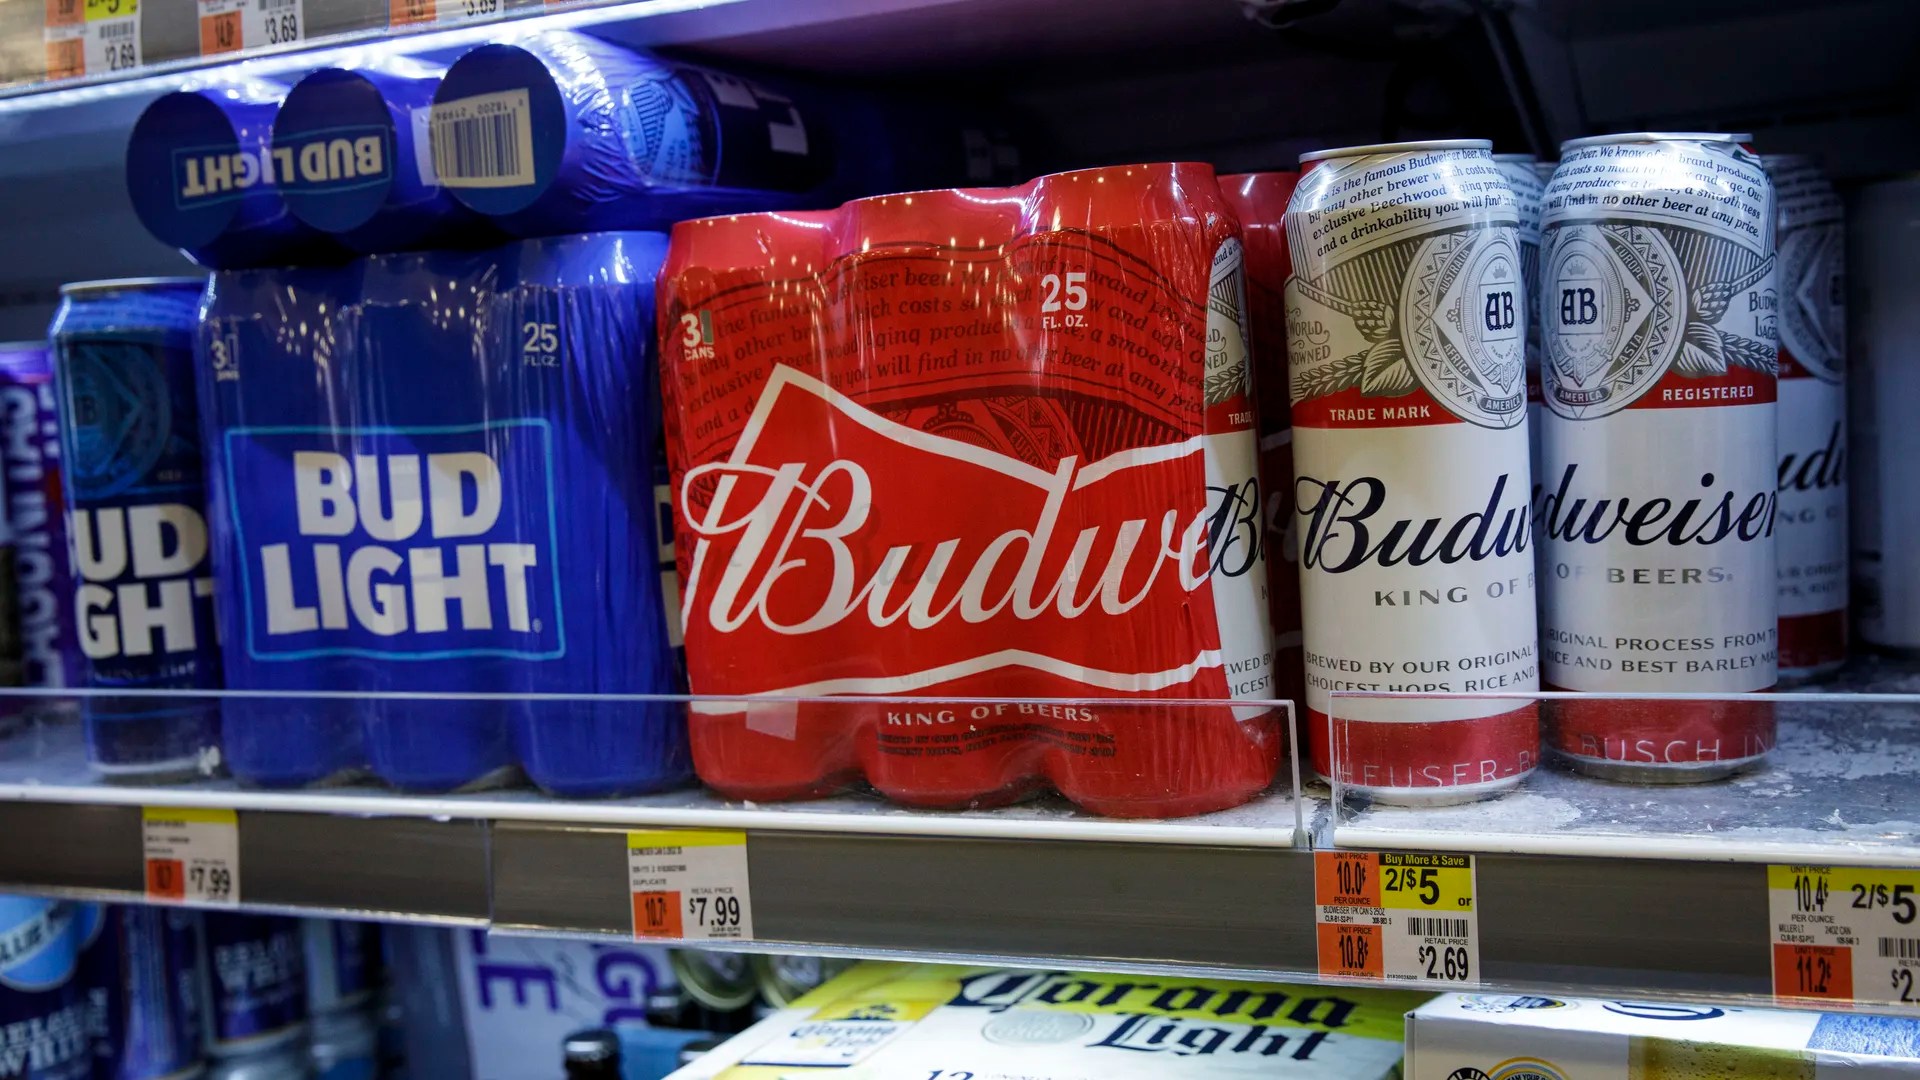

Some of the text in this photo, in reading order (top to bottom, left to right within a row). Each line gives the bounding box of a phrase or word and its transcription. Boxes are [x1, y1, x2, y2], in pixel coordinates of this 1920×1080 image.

[265, 15, 298, 44] $3.69
[182, 136, 383, 198] BUD LIGHT
[1332, 148, 1479, 196] is the famous Budweiser beer.
[1570, 164, 1592, 176] costs
[1593, 164, 1605, 173] so
[1695, 171, 1718, 185] and
[1722, 180, 1745, 193] ge.
[1580, 145, 1762, 187] beer. We know brand produced
[1308, 212, 1321, 224] by
[1324, 199, 1345, 215] any
[1350, 185, 1383, 204] other
[1387, 173, 1429, 192] brewer
[1465, 165, 1486, 176] costs
[1684, 187, 1693, 195] a
[1696, 189, 1761, 219] smoothness
[1313, 181, 1481, 240] exclusive Beechwood ging
[1317, 194, 1501, 257] and a drinkability you will find
[1563, 193, 1585, 209] find
[1588, 193, 1598, 204] in
[1602, 195, 1619, 205] no
[1622, 192, 1659, 207] other
[1662, 196, 1693, 212] beer
[1695, 205, 1709, 217] at
[1711, 210, 1734, 226] any
[1734, 218, 1760, 238] price.
[1439, 249, 1470, 294] AUSTRALIA
[1614, 245, 1644, 281] EUROPE
[1041, 272, 1088, 313] 25
[1089, 268, 1148, 304] brand
[1042, 315, 1088, 329] FL. OZ.
[1485, 291, 1515, 331] AB
[1561, 287, 1598, 326] AB
[523, 322, 558, 353] 25
[681, 313, 701, 347] 3
[734, 332, 785, 361] other
[899, 297, 952, 315] costs
[1108, 305, 1148, 332] and
[1090, 328, 1103, 343] a
[1289, 318, 1322, 337] WORLD
[684, 346, 716, 361] CANS
[1444, 344, 1471, 378] AFRICA
[1620, 333, 1644, 364] ASIA
[695, 414, 723, 440] and
[728, 409, 741, 423] a
[876, 355, 911, 377] will
[918, 349, 958, 376] find
[965, 348, 984, 364] in
[989, 348, 1012, 362] no
[1061, 345, 1101, 373] beer
[1105, 361, 1124, 378] at
[1129, 373, 1167, 400] any
[1558, 389, 1603, 402] AMERICA
[1663, 385, 1754, 400] REGISTERED
[1330, 406, 1430, 421] TRADE MARK
[293, 451, 502, 541] BUD
[65, 504, 208, 582] UD
[260, 543, 537, 636] LIGHT
[1374, 578, 1519, 606] KING OF
[1549, 628, 1766, 651] RIGINAL PROCESS FROM
[1306, 645, 1532, 674] BREWED BY OUR ORIGINAL
[1574, 655, 1758, 673] AND BEST BARLEY
[1465, 674, 1508, 692] RICE
[1512, 665, 1535, 685] AND
[887, 710, 955, 726] KING
[971, 704, 1008, 719] OF
[1581, 736, 1721, 765] BUSCH
[1333, 852, 1348, 860] UNIT
[1385, 853, 1465, 866] Buy More & Save
[1790, 866, 1832, 874] UNIT PRICE
[1334, 896, 1371, 905] PER OUNCE
[1385, 868, 1440, 905] 2/$5
[1458, 897, 1472, 906] or
[689, 896, 740, 926] $7.99
[1323, 905, 1350, 914] BUDWEISER
[1791, 914, 1835, 924] PER OUNCE
[1851, 883, 1917, 924] 2/$5
[1337, 926, 1372, 935] UNIT PRICE
[1424, 937, 1468, 946] RETAIL PRICE
[1779, 924, 1797, 933] MILLER
[1418, 945, 1469, 981] $2.69
[947, 968, 1361, 1029] Corona
[1084, 1010, 1338, 1063] Light
